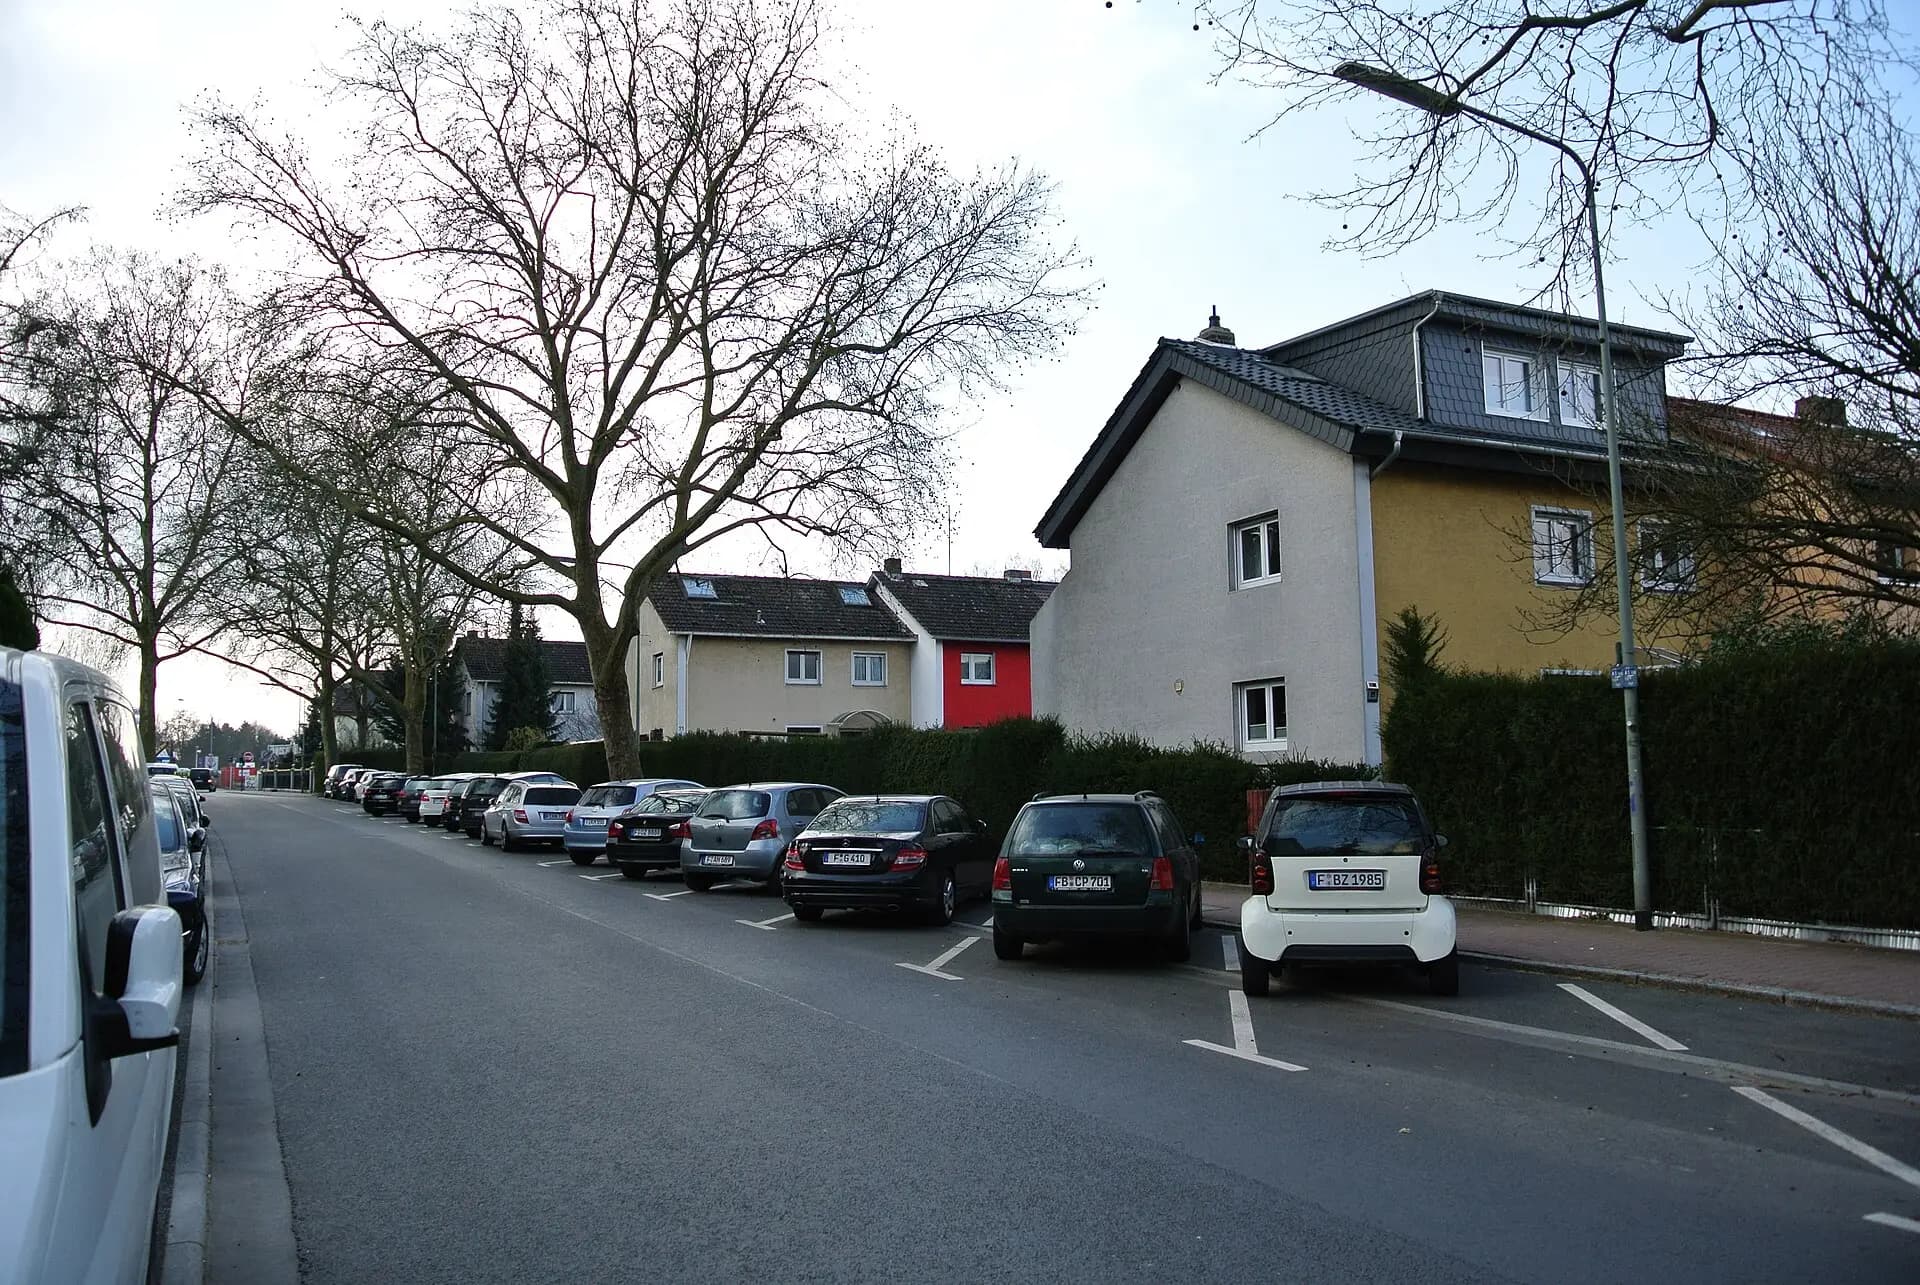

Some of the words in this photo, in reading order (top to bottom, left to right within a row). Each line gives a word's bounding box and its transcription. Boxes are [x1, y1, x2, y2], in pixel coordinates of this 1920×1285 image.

[1055, 876, 1069, 887] FB
[1075, 876, 1089, 887] CP
[1090, 876, 1110, 887] 701
[1333, 874, 1349, 886] BZ
[1351, 874, 1382, 886] 1985
